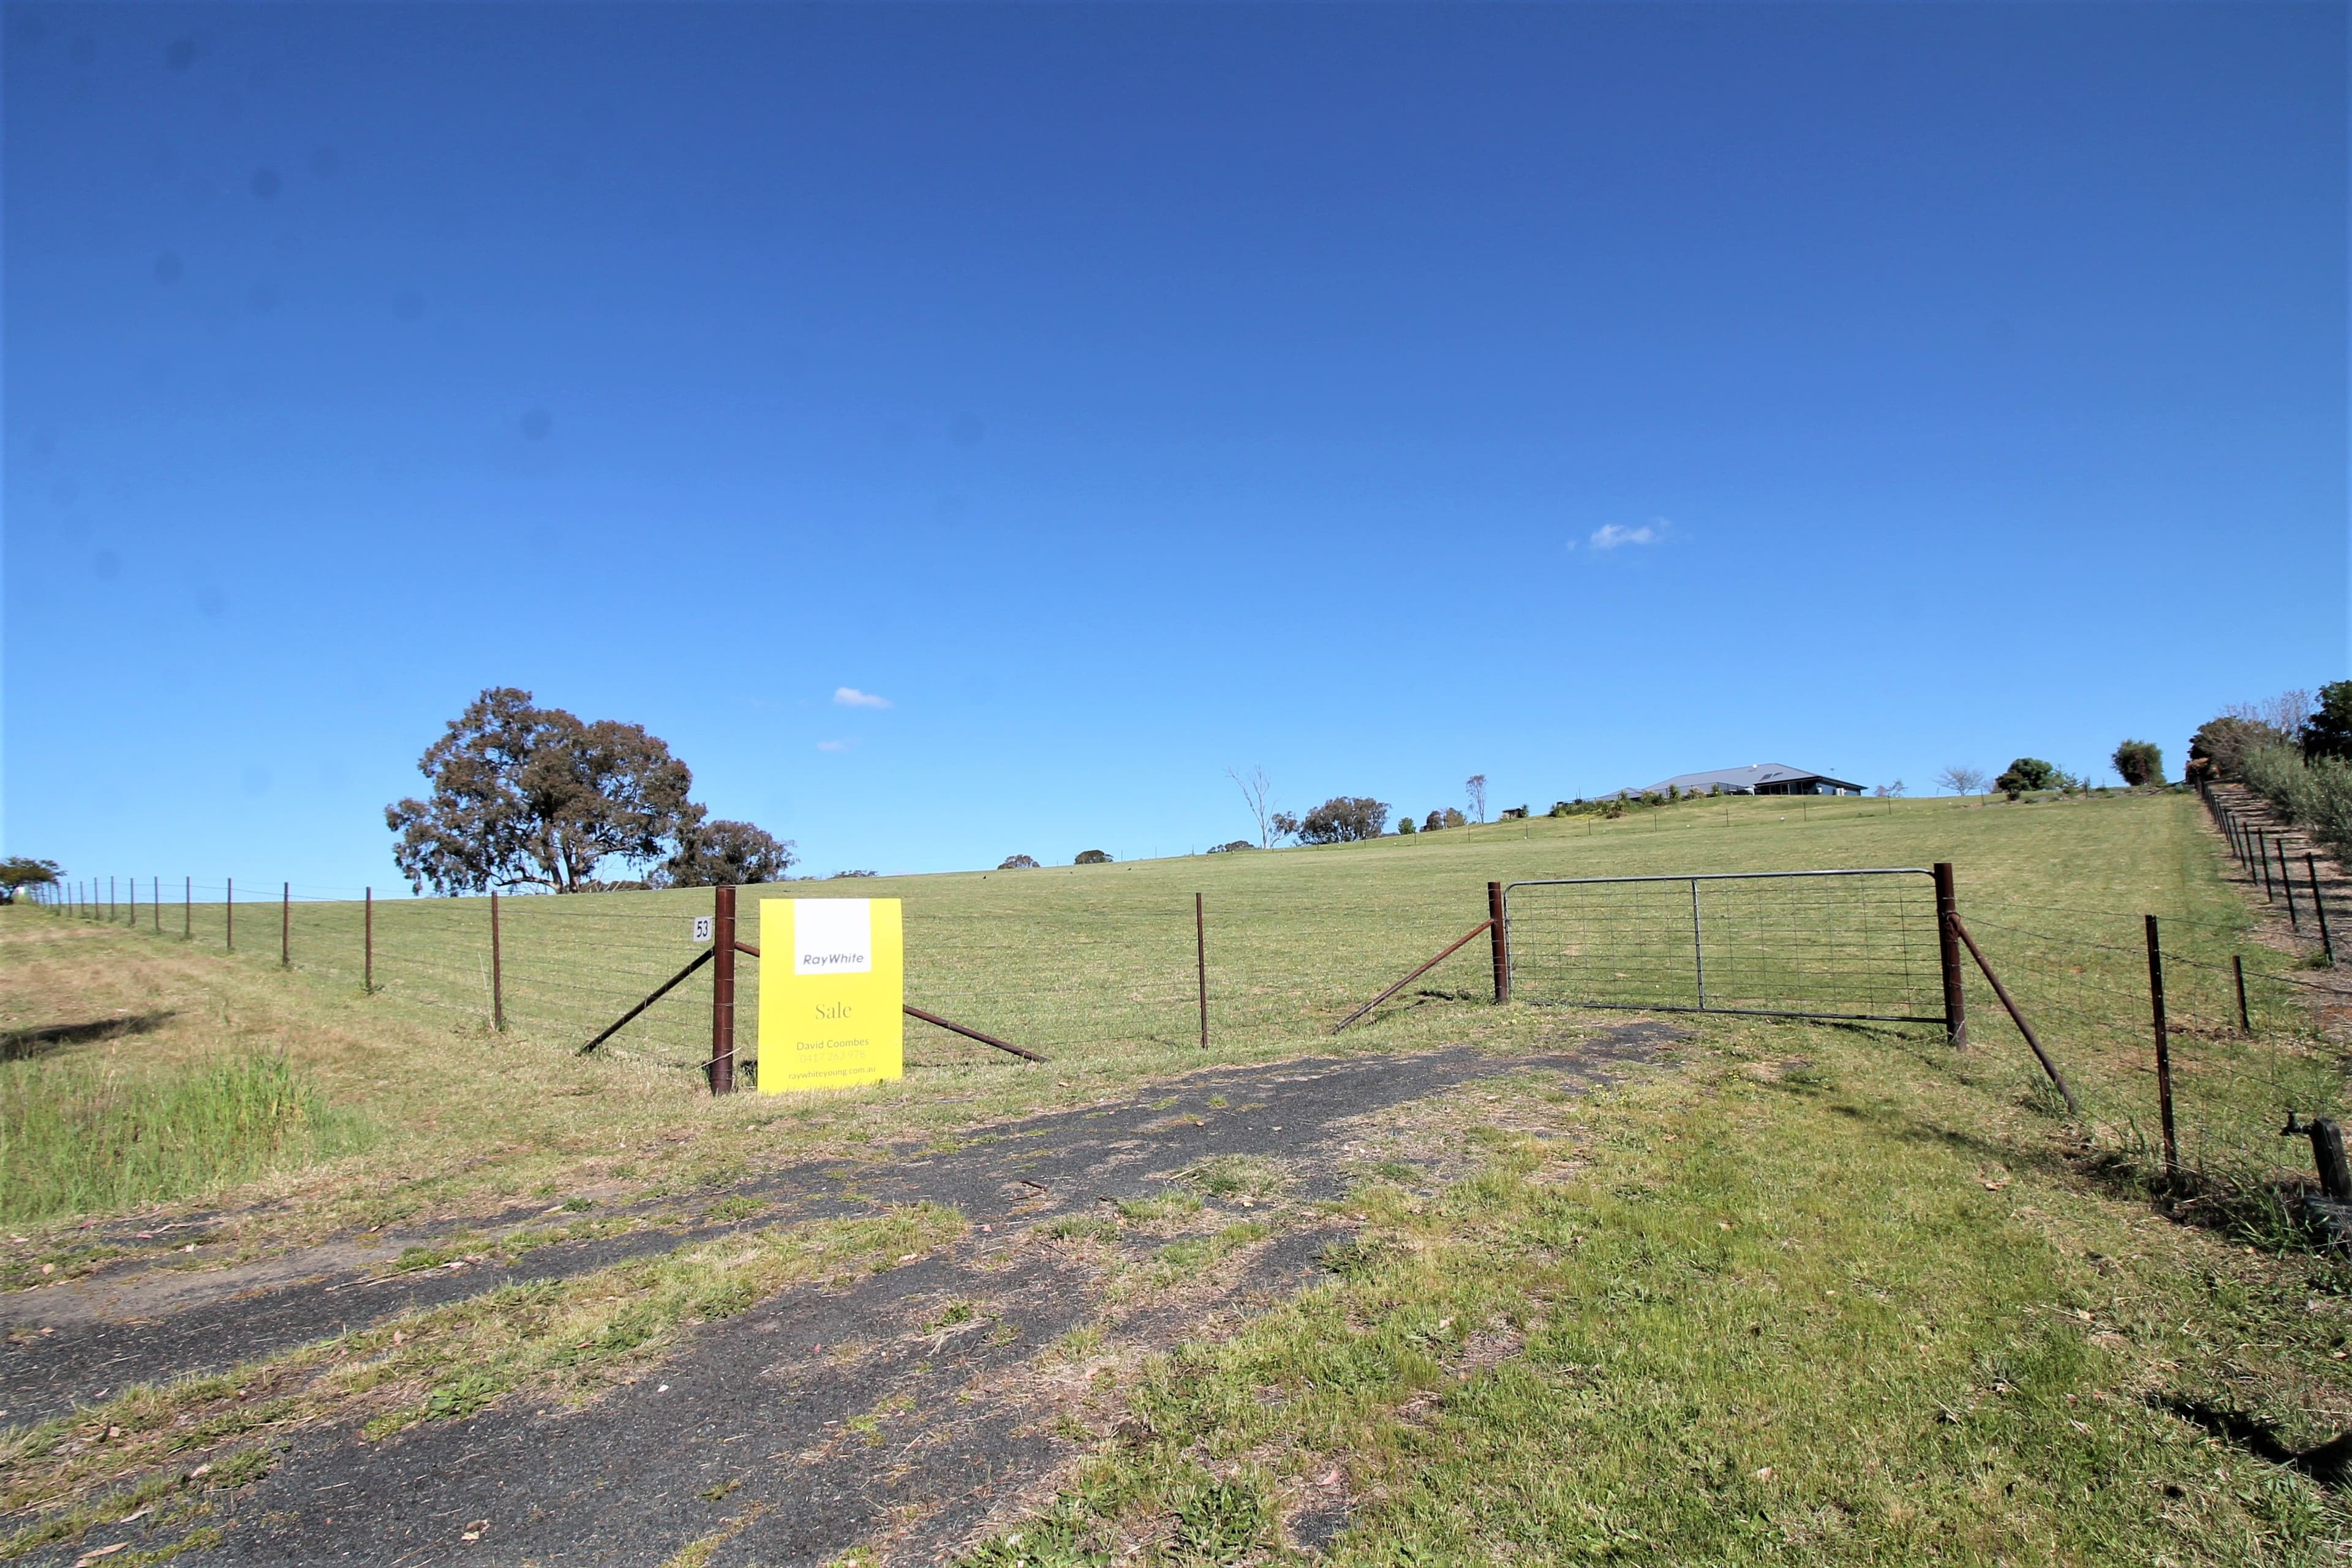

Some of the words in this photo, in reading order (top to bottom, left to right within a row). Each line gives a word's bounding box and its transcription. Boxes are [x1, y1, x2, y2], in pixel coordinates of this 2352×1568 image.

[697, 920, 708, 938] 53
[815, 1001, 852, 1020] Sale
[796, 1041, 824, 1051] David
[827, 1038, 869, 1048] Coombes
[789, 1066, 876, 1080] raywhiteyoung.com.au
